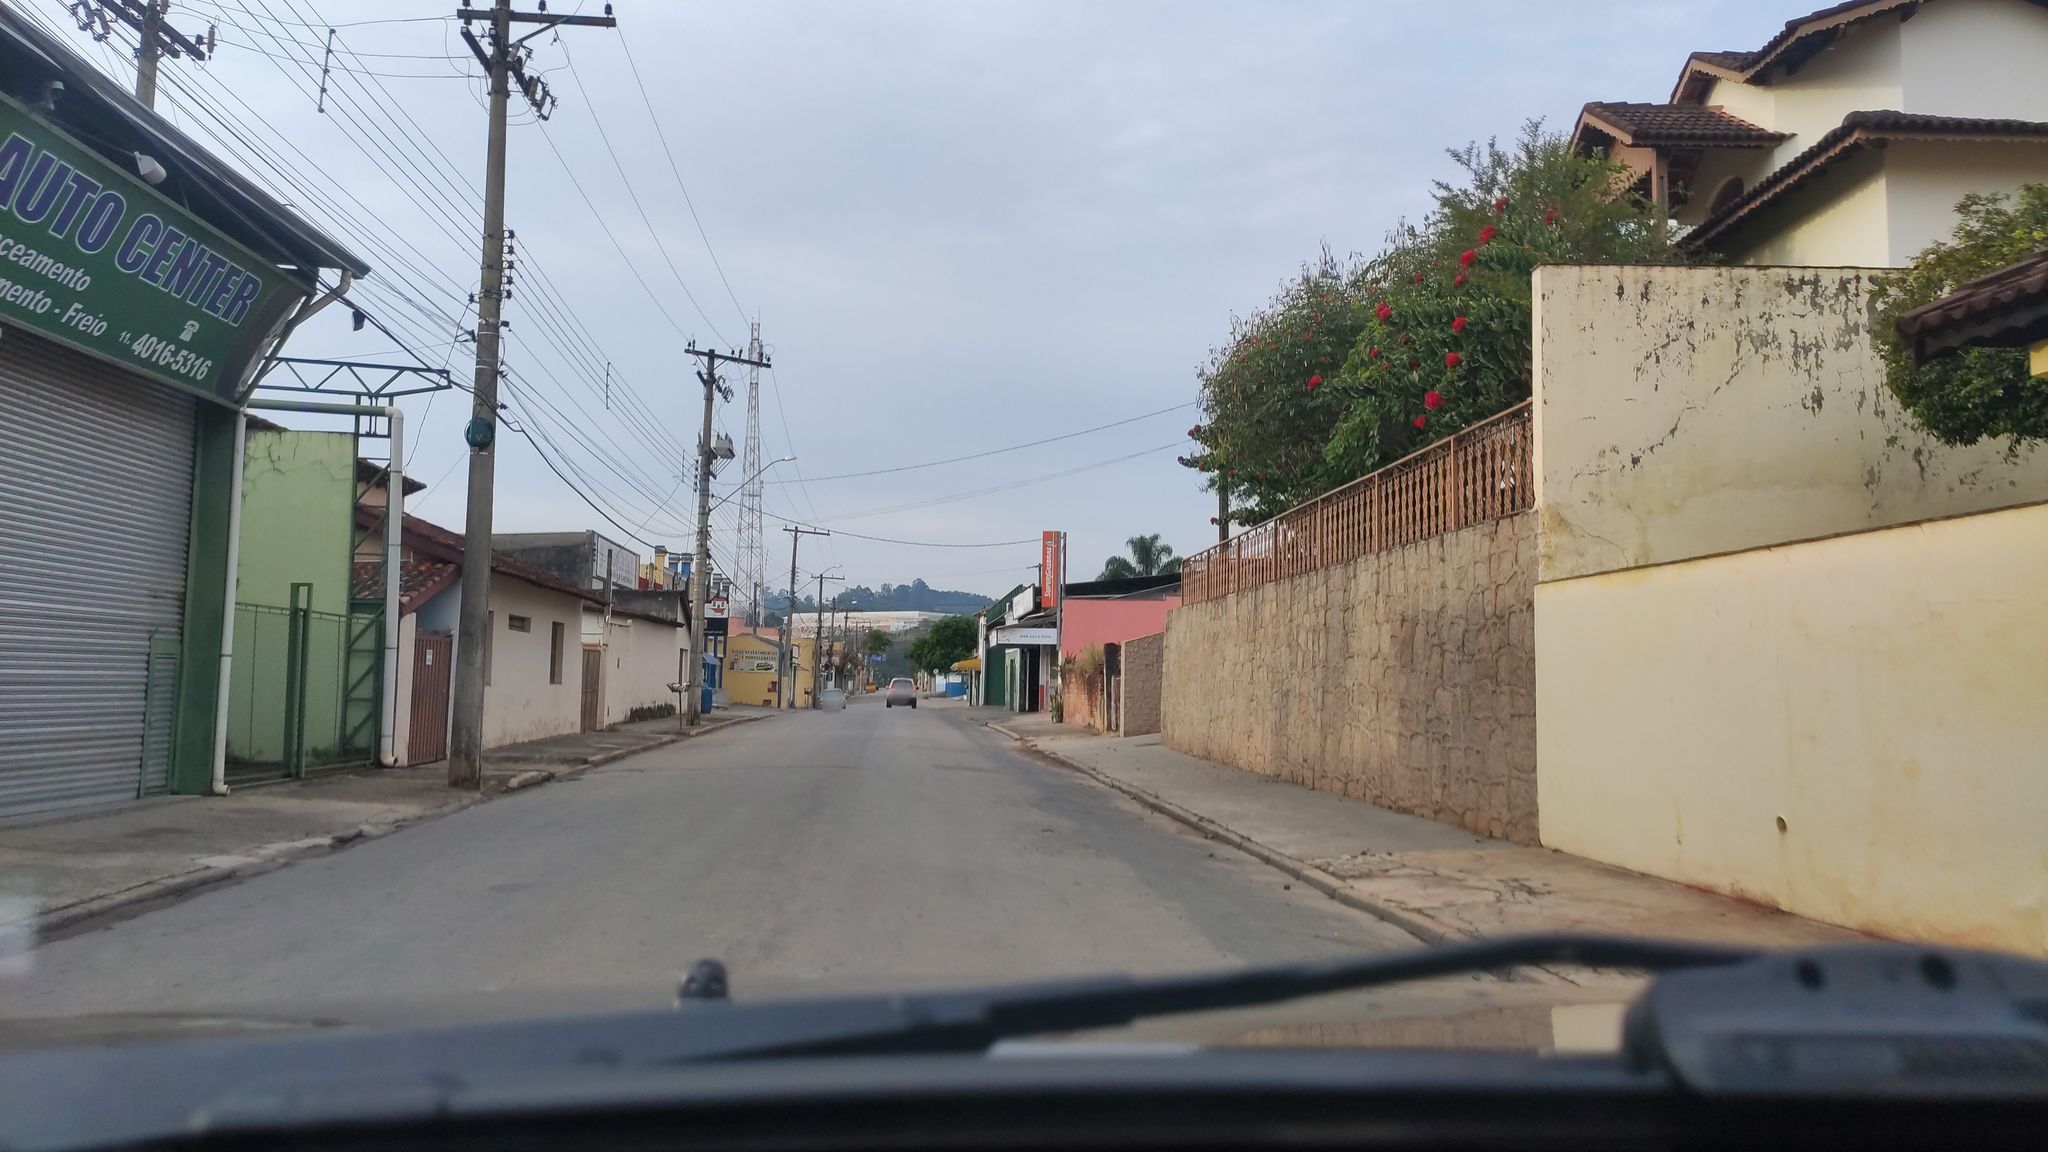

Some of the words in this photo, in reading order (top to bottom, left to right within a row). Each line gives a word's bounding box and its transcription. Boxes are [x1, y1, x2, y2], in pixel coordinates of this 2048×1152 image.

[0, 132, 127, 254] AUTO
[115, 213, 262, 327] CENTER
[0, 233, 91, 291] ceamento
[61, 302, 107, 336] Freio
[131, 333, 212, 380] 4016-5316
